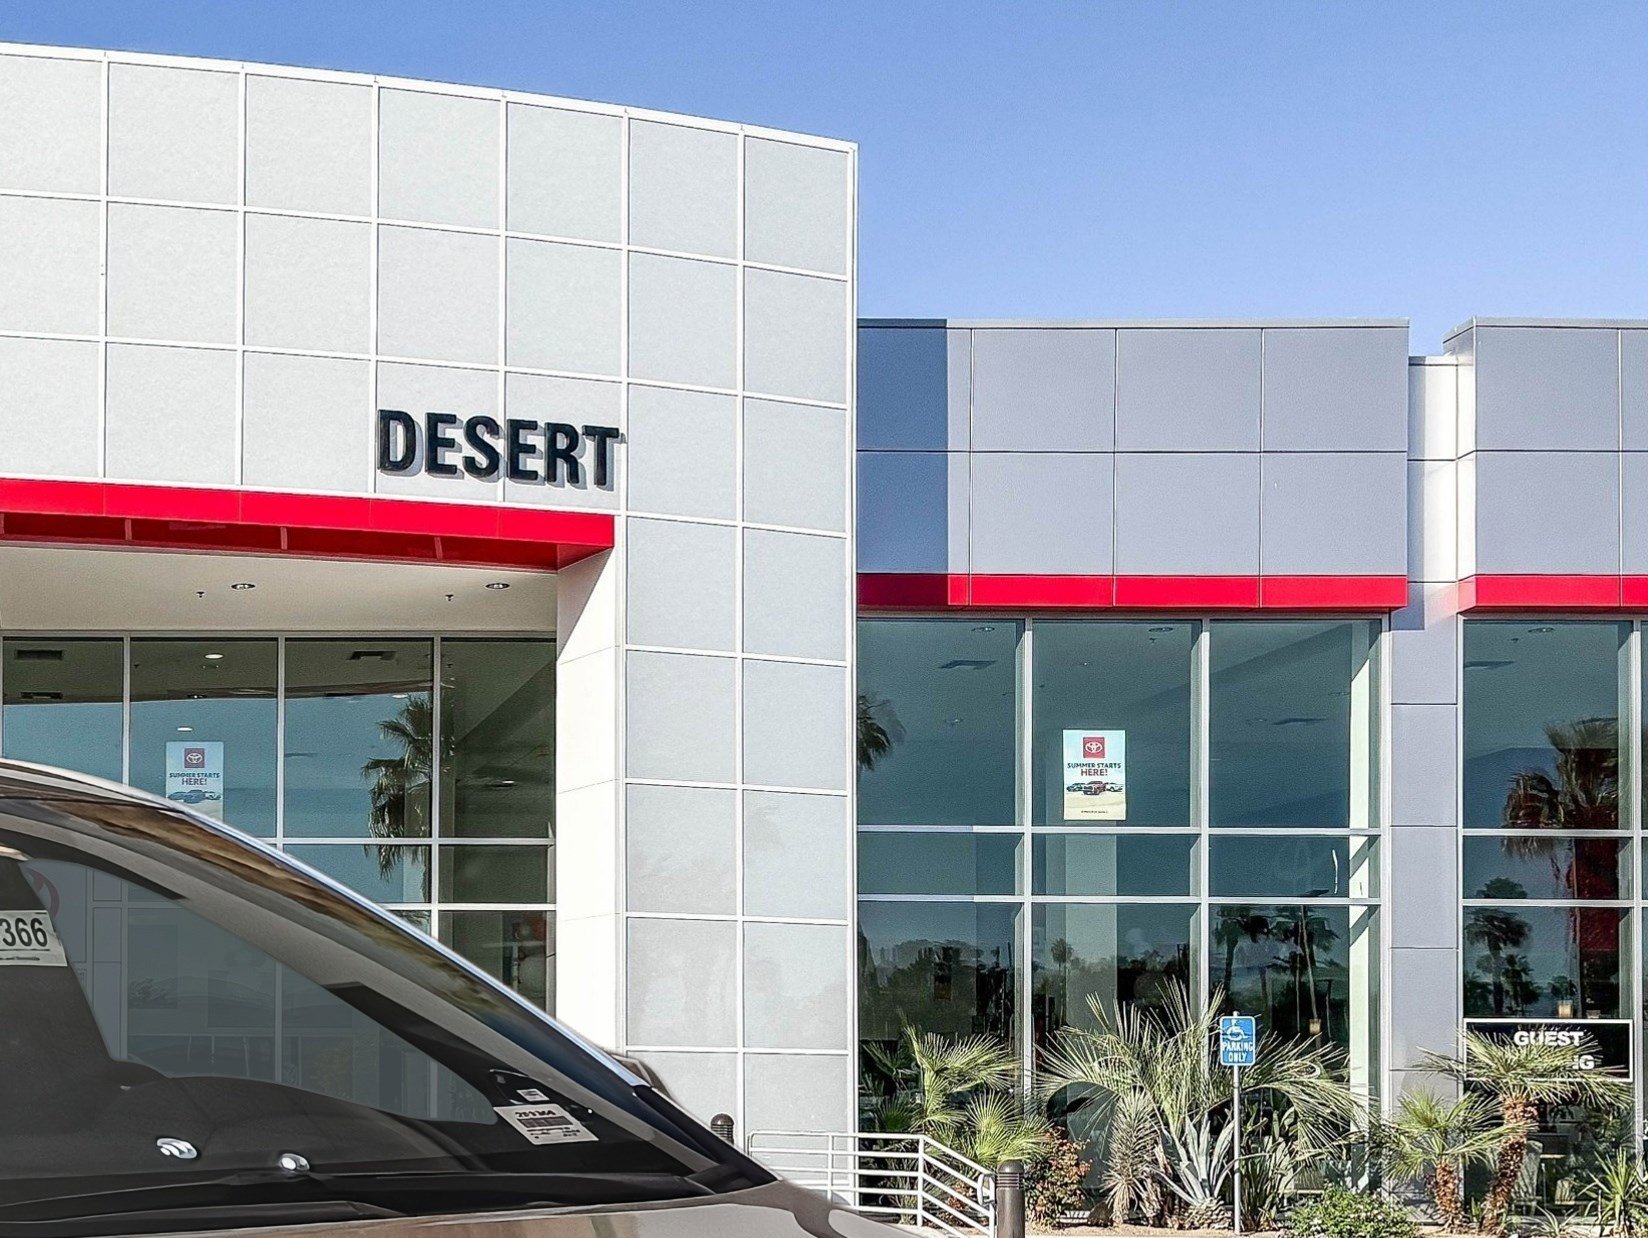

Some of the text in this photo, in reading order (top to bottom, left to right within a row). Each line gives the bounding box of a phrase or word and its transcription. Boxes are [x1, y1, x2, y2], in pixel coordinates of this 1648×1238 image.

[377, 409, 620, 486] DESERT
[1080, 768, 1108, 777] HERE!
[181, 778, 207, 786] HERE!
[1513, 1031, 1584, 1047] GUEST
[1222, 1040, 1254, 1051] PARKING
[1228, 1052, 1247, 1062] ONLY
